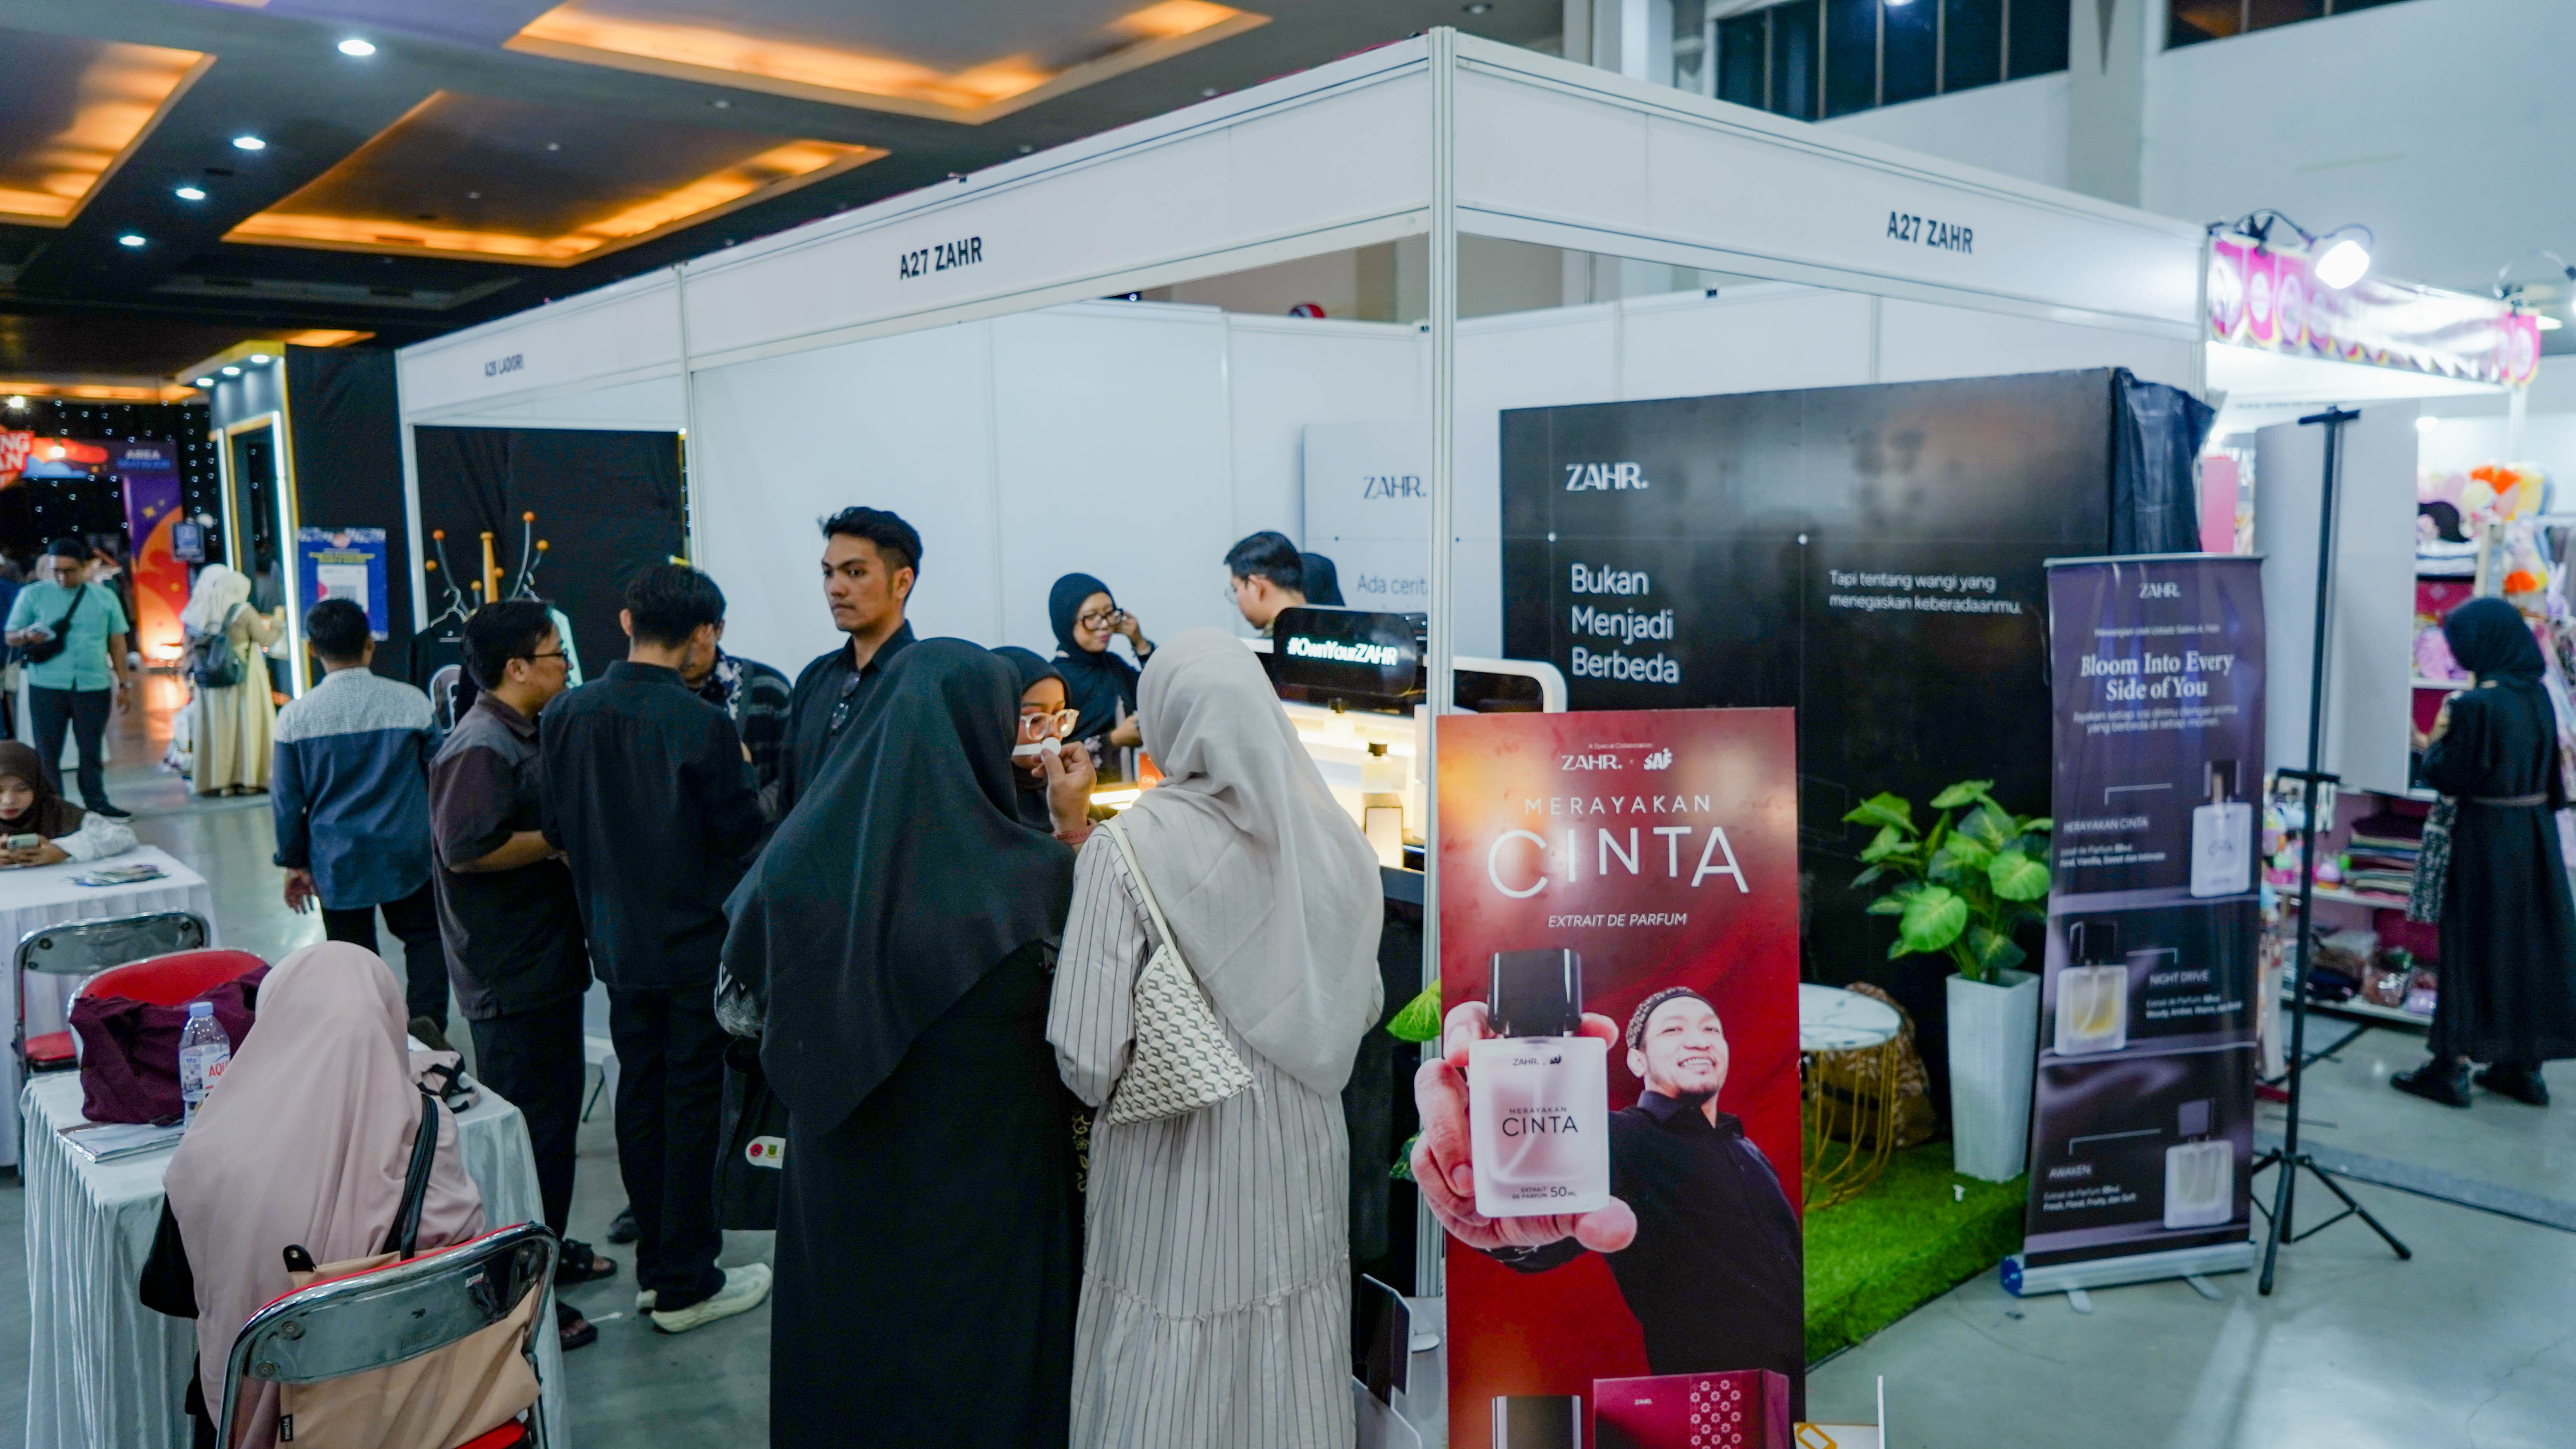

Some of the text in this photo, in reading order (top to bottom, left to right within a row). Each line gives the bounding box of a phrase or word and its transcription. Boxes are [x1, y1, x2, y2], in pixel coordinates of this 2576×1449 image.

[1887, 211, 1972, 254] A27 ZAHR
[901, 236, 982, 279] A27 ZAHR
[1363, 476, 1426, 499] ZAHR.
[1566, 462, 1649, 491] ZAHR.
[1357, 573, 1428, 595] Ada cerit
[1571, 563, 1649, 595] Bukan
[1829, 570, 1996, 594] Tapi tentang wangi yang
[1829, 594, 1914, 612] menegaskan
[1572, 605, 1674, 645] Menjadi
[1288, 637, 1397, 666] #OwnYourZAHR
[1572, 646, 1680, 684] Berbeda
[2081, 651, 2235, 676] Bloom Into Every
[2107, 676, 2208, 701] Side of You
[1562, 754, 1623, 770] ZAHR.
[1525, 794, 1710, 815] MERAYAKAN
[2063, 816, 2148, 833] MERAYAKAN CINTA
[1488, 827, 1749, 898] CINTA
[1548, 913, 1687, 928] EXTRAIT DE PARFUM
[2149, 970, 2210, 985] NIGHT DRIVE
[209, 1061, 230, 1077] AQU
[1510, 1106, 1567, 1114] MERAYAKAN
[1503, 1116, 1579, 1137] CINTA
[1551, 1186, 1566, 1197] 50
